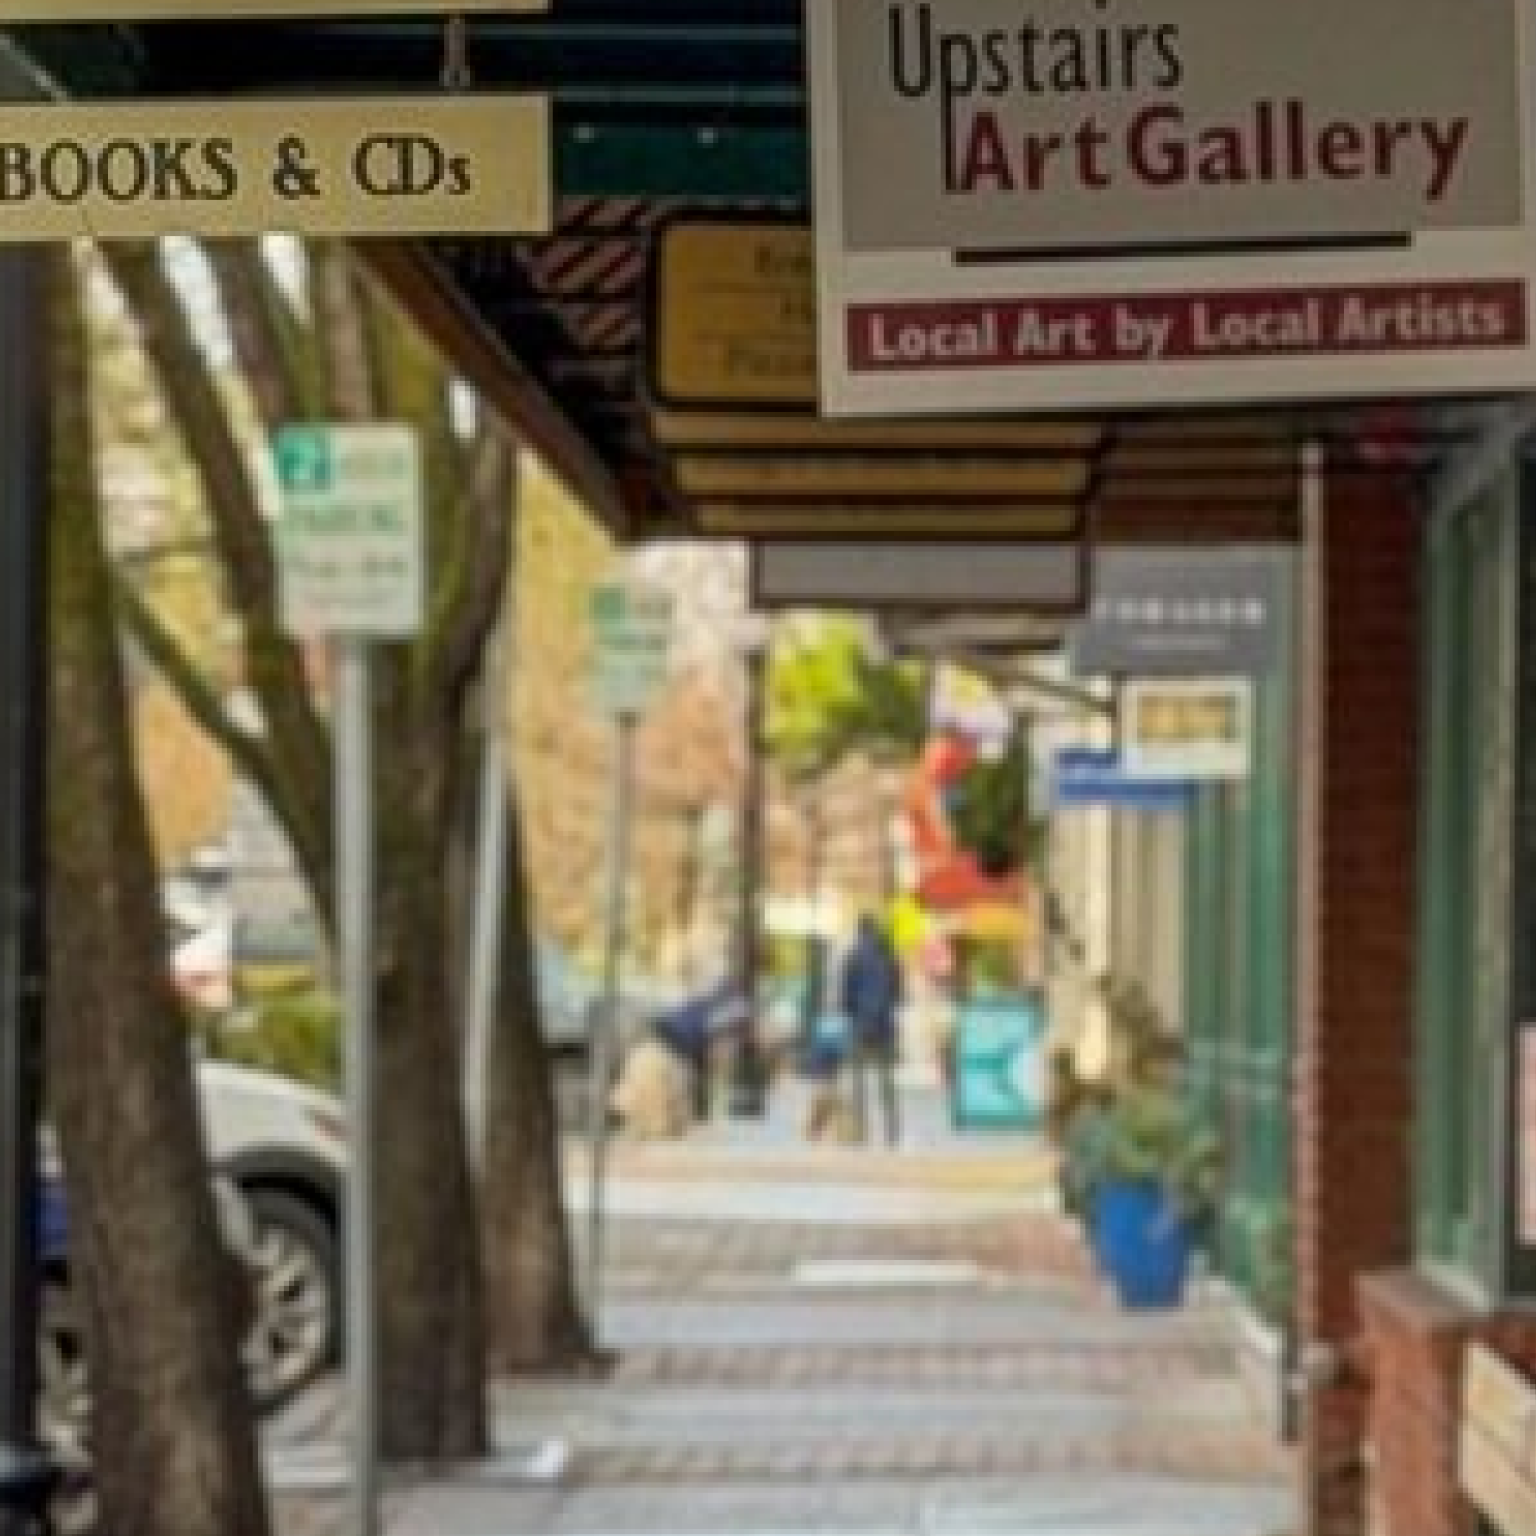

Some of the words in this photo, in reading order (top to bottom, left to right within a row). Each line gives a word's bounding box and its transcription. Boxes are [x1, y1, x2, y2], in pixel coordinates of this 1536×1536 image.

[271, 136, 322, 201] &
[354, 131, 472, 197] CDs
[959, 109, 1111, 194] Art
[1125, 98, 1470, 202] Gallery
[870, 313, 998, 362] Local
[1016, 309, 1096, 352] Art
[1114, 305, 1170, 360] by
[1192, 301, 1323, 348] Local
[1335, 292, 1505, 340] Artists
